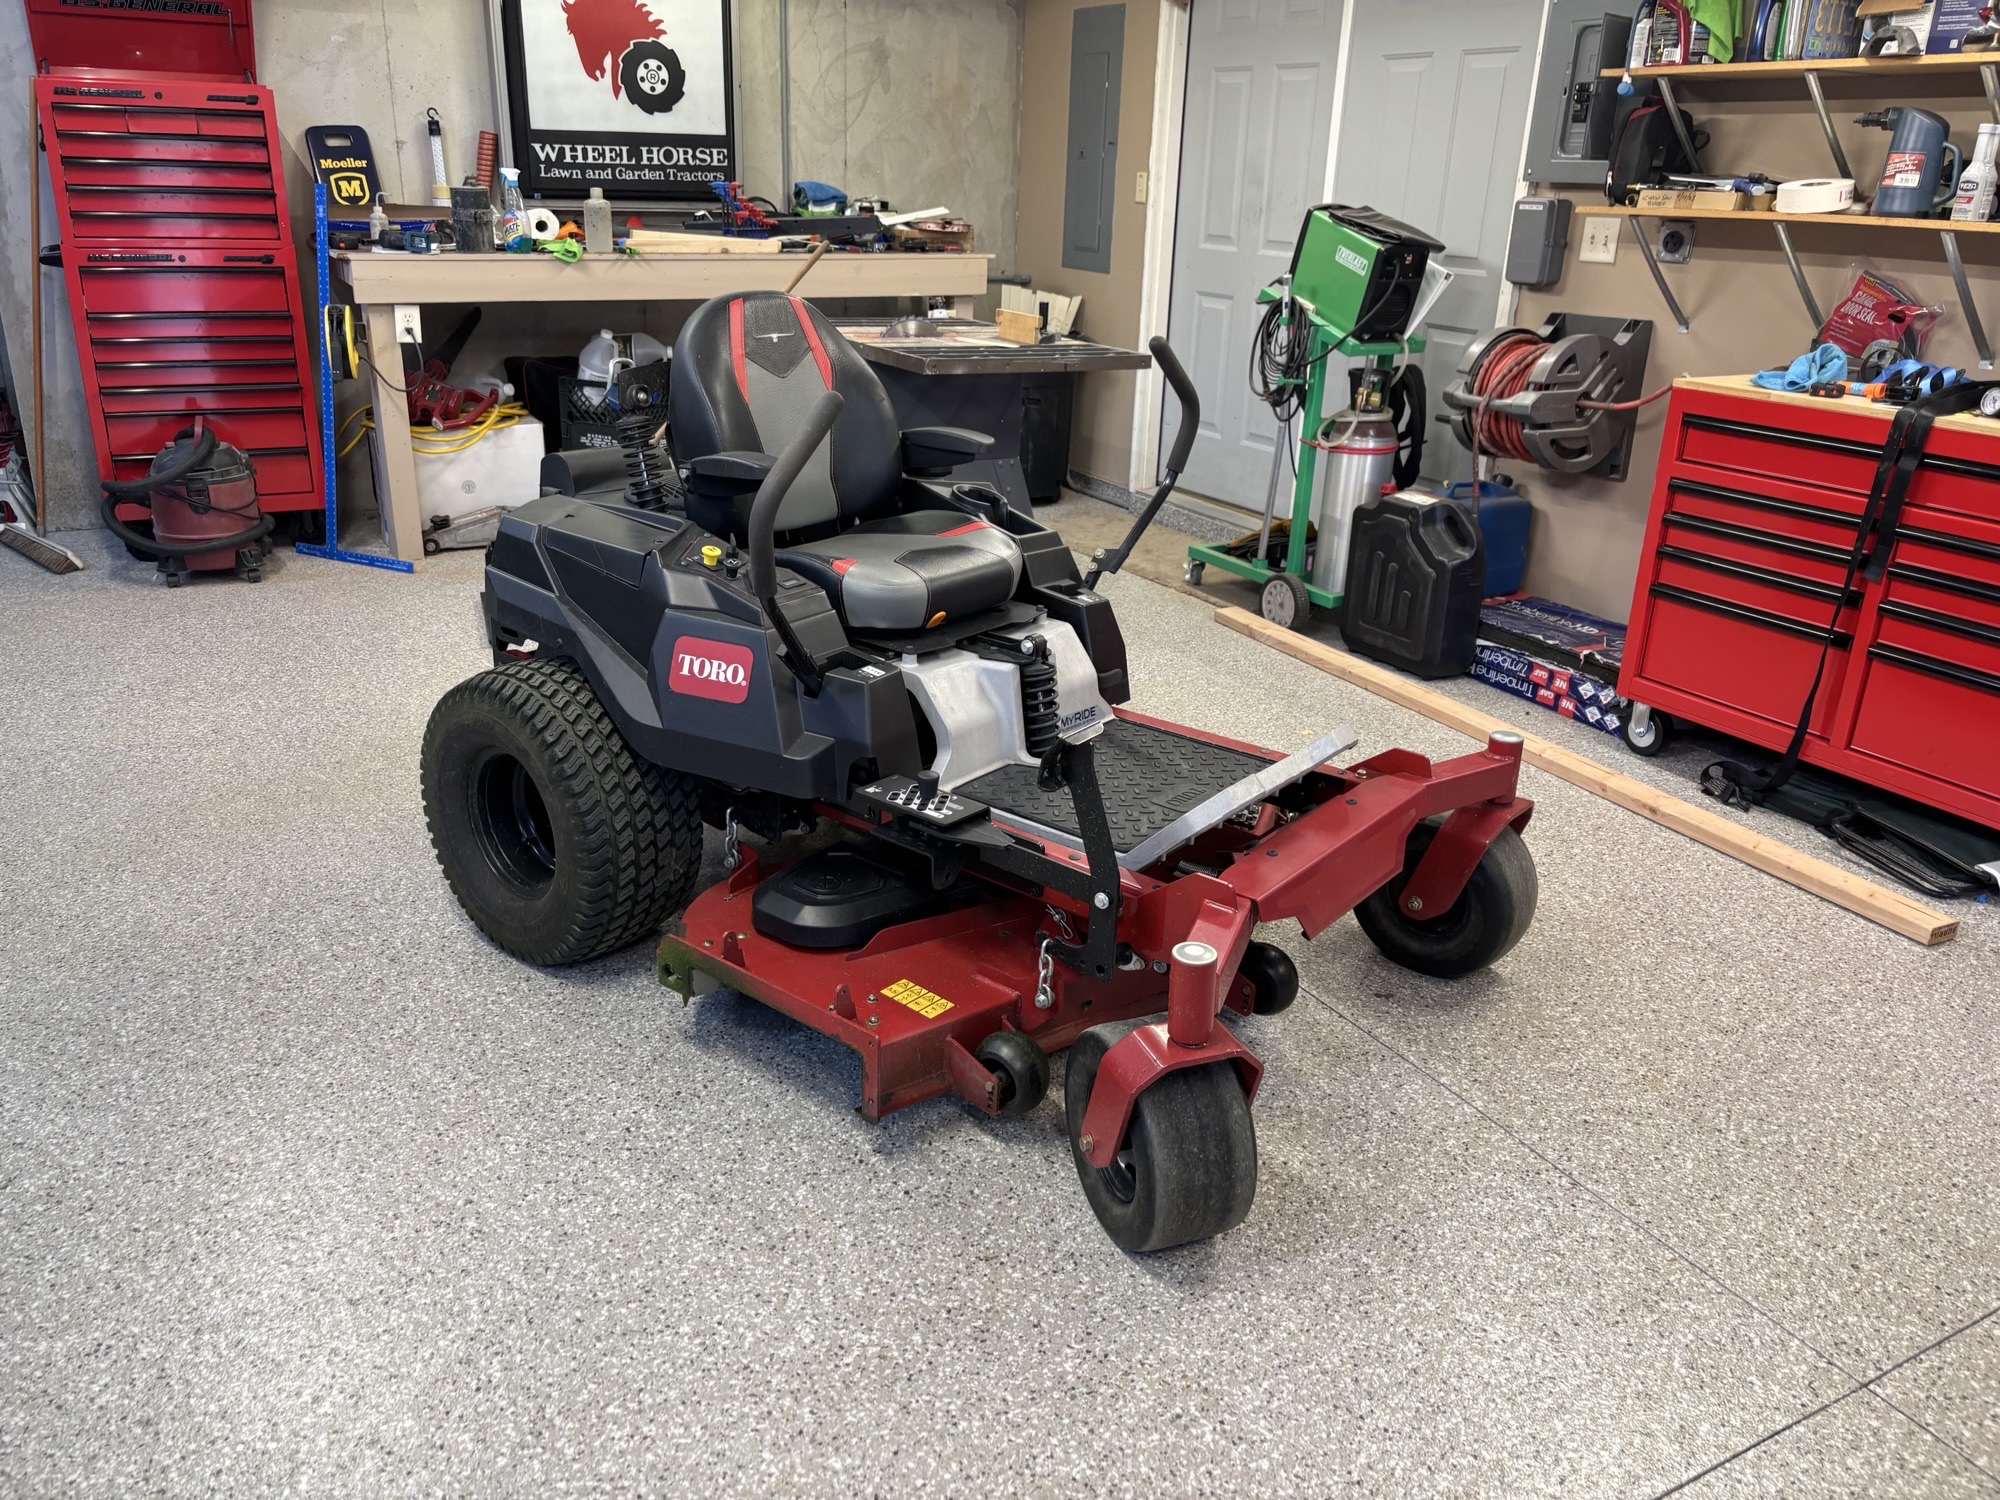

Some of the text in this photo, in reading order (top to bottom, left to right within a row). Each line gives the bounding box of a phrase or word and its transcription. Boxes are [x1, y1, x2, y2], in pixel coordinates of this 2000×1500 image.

[107, 0, 228, 15] GENERAL
[320, 157, 368, 169] Moeller
[531, 143, 728, 167] WHEEL HORSE
[539, 164, 725, 182] Lawn and Garden Tractors
[338, 180, 363, 198] M
[1852, 290, 1878, 309] GARAGE
[1840, 301, 1878, 325] DOOR SEAL
[1476, 665, 1534, 698] Timberline
